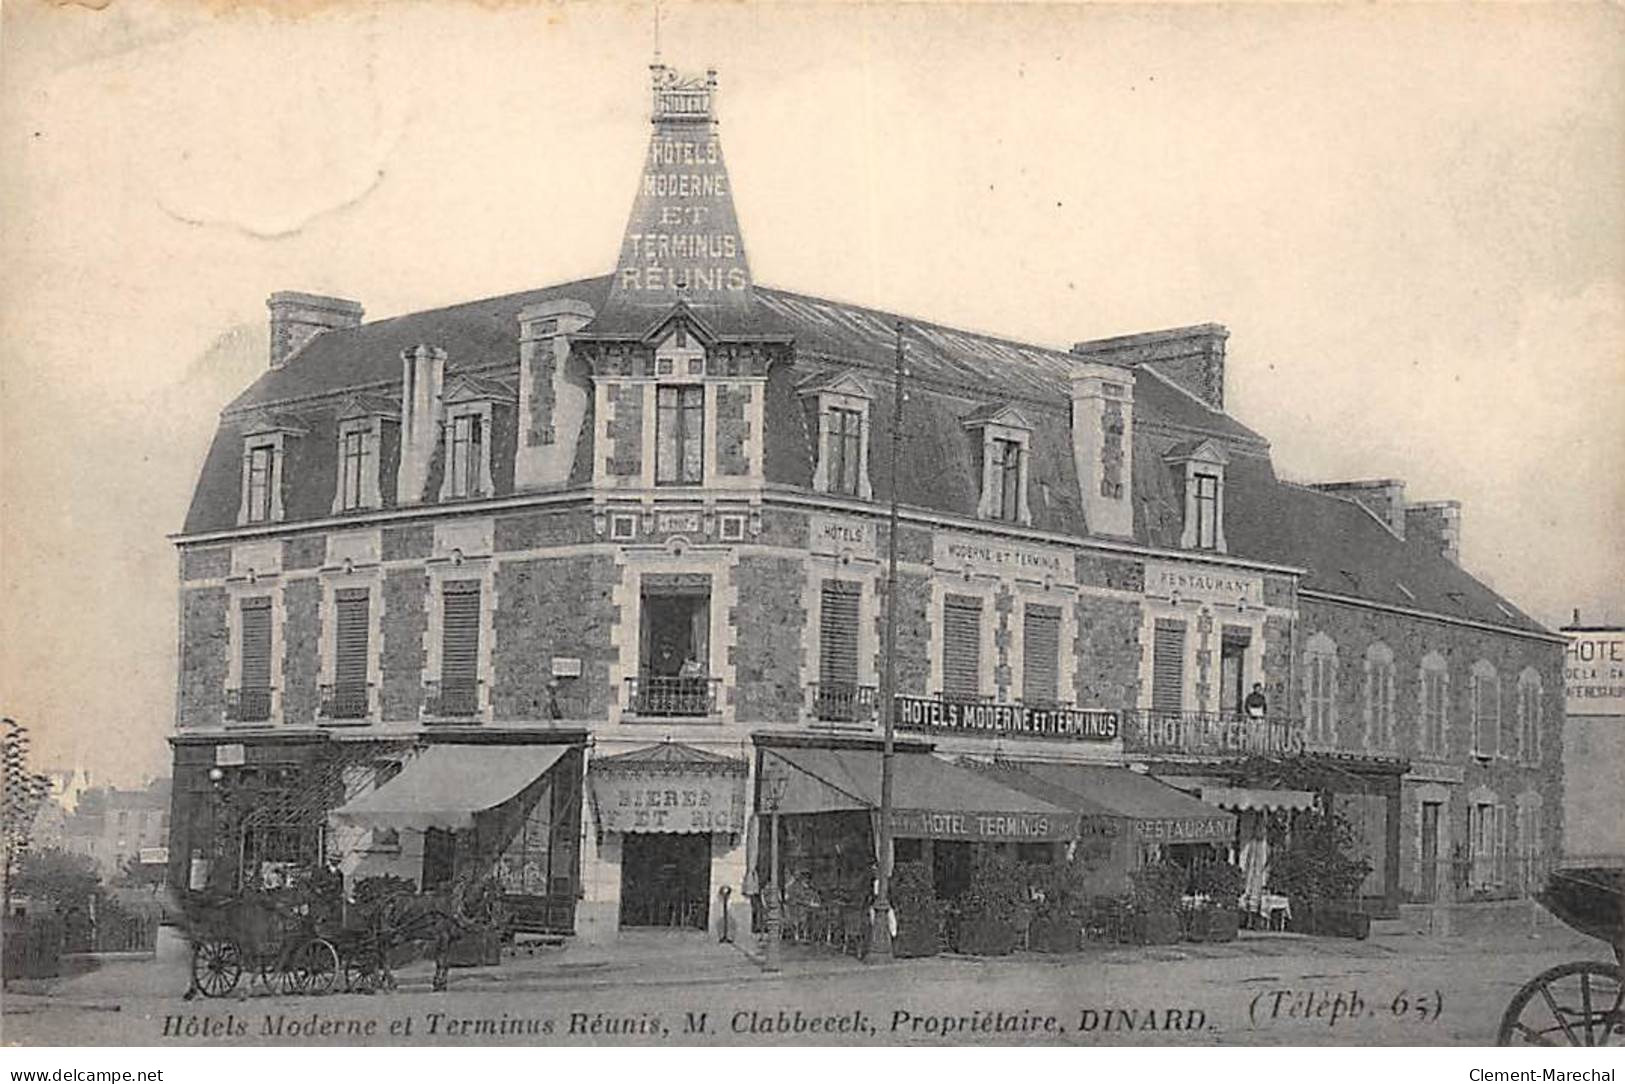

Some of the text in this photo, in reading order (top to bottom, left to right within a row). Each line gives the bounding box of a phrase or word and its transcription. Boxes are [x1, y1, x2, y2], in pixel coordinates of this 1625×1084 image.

[643, 174, 726, 197] MODERNE
[660, 206, 709, 225] ET
[631, 233, 736, 258] TERMINUS
[622, 259, 747, 291] RÉUNIS
[902, 699, 1116, 737] HOTELS MODERNE ET TERMINUS
[923, 813, 968, 834] HOTEL
[976, 815, 1049, 836] TERMINUS
[1136, 819, 1237, 840] RESTAURANT
